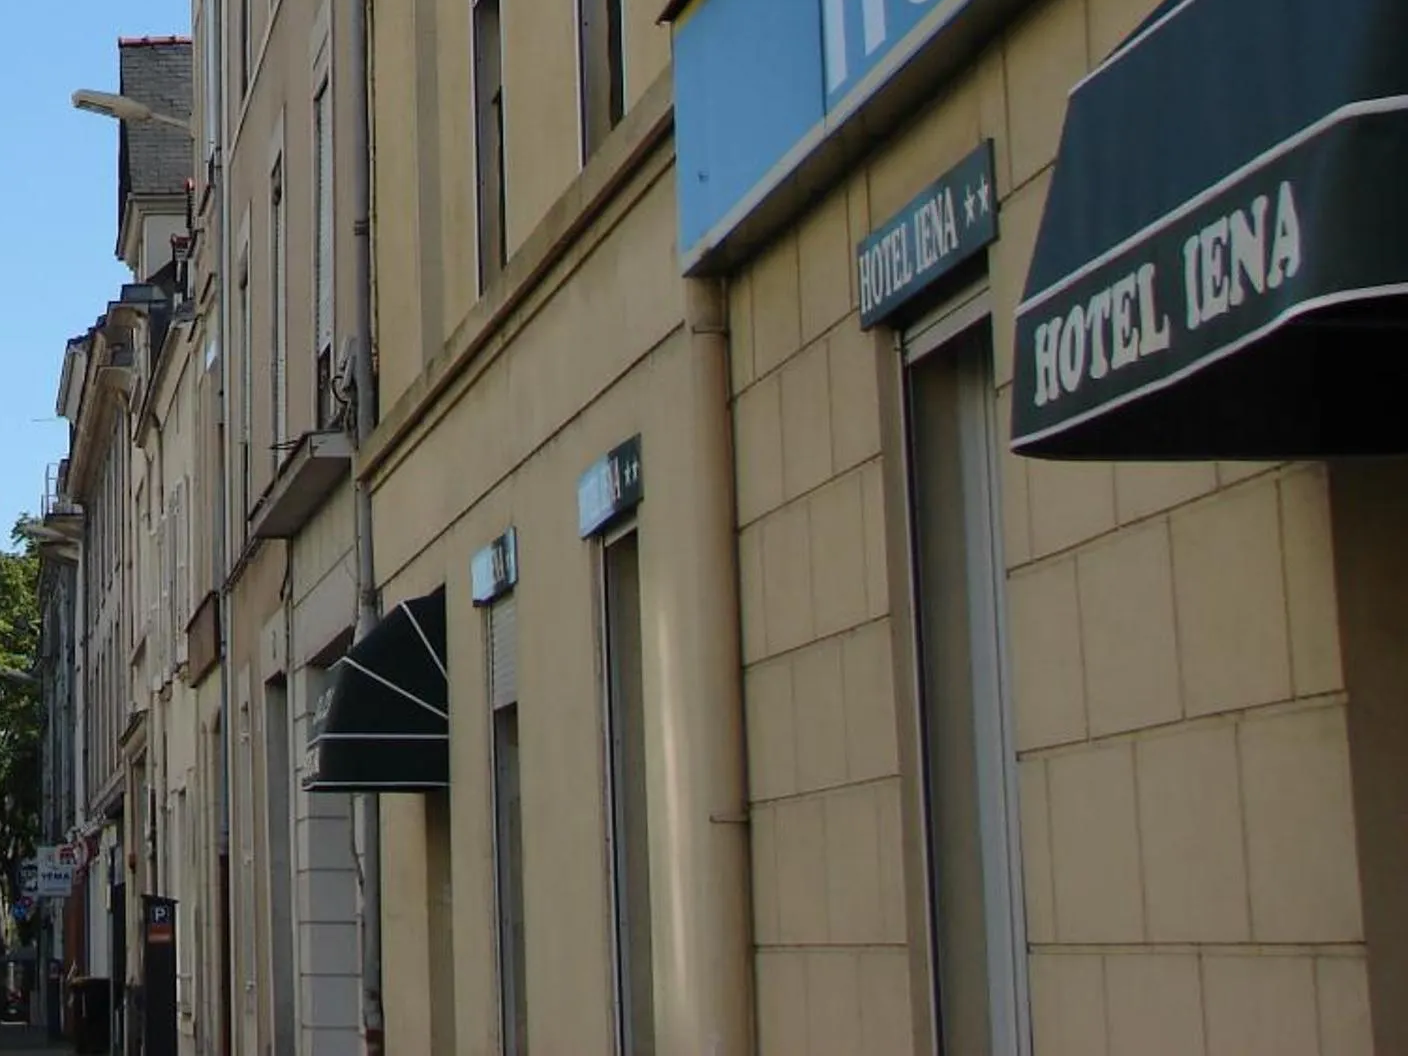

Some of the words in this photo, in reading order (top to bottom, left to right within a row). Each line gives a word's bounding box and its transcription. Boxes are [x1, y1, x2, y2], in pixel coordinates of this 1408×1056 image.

[859, 222, 913, 314] HOTEL
[914, 186, 960, 275] IENA
[1034, 263, 1170, 406] HOTEL
[1183, 181, 1300, 330] IENA
[155, 907, 166, 921] P
